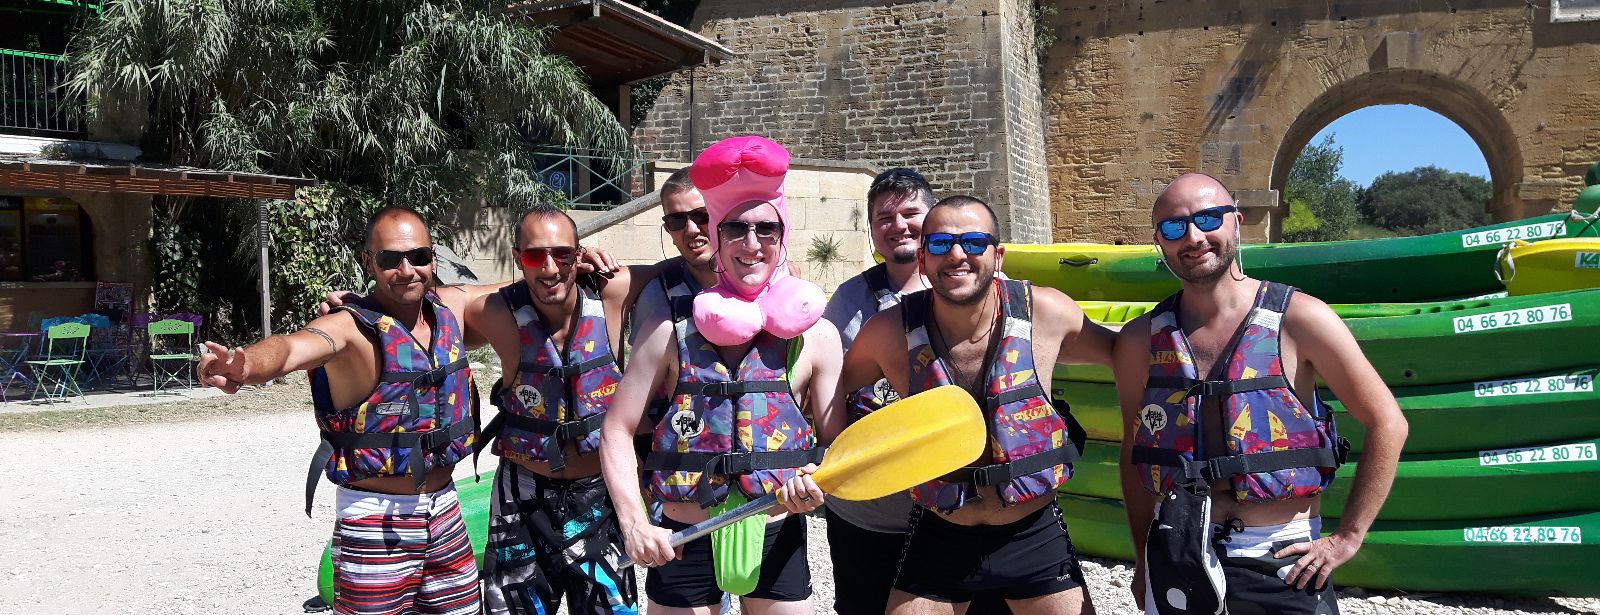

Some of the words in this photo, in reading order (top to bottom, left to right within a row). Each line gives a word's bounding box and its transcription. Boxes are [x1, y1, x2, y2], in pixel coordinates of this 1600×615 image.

[1465, 234, 1481, 246] 04
[1486, 231, 1500, 243] 66
[1506, 228, 1521, 240] 22
[1527, 225, 1542, 237] 80
[1547, 222, 1563, 235] 76
[1457, 318, 1474, 331] 04
[1480, 314, 1497, 328] 66
[1504, 312, 1520, 326] 22
[1526, 309, 1544, 323] 80
[1550, 306, 1568, 320] 76
[1477, 383, 1494, 395] 04
[1501, 381, 1518, 394] 66
[1525, 379, 1541, 392] 22
[1548, 378, 1565, 391] 80
[1571, 376, 1589, 390] 76
[1482, 452, 1499, 464] 04
[1505, 450, 1523, 463] 66
[1529, 448, 1546, 461] 22
[1552, 446, 1569, 460] 80
[1575, 445, 1593, 459] 76
[1465, 527, 1484, 541] 04
[1489, 528, 1508, 542] 66
[1513, 528, 1531, 542] 22
[1537, 527, 1556, 542] 80
[1561, 527, 1580, 542] 76
